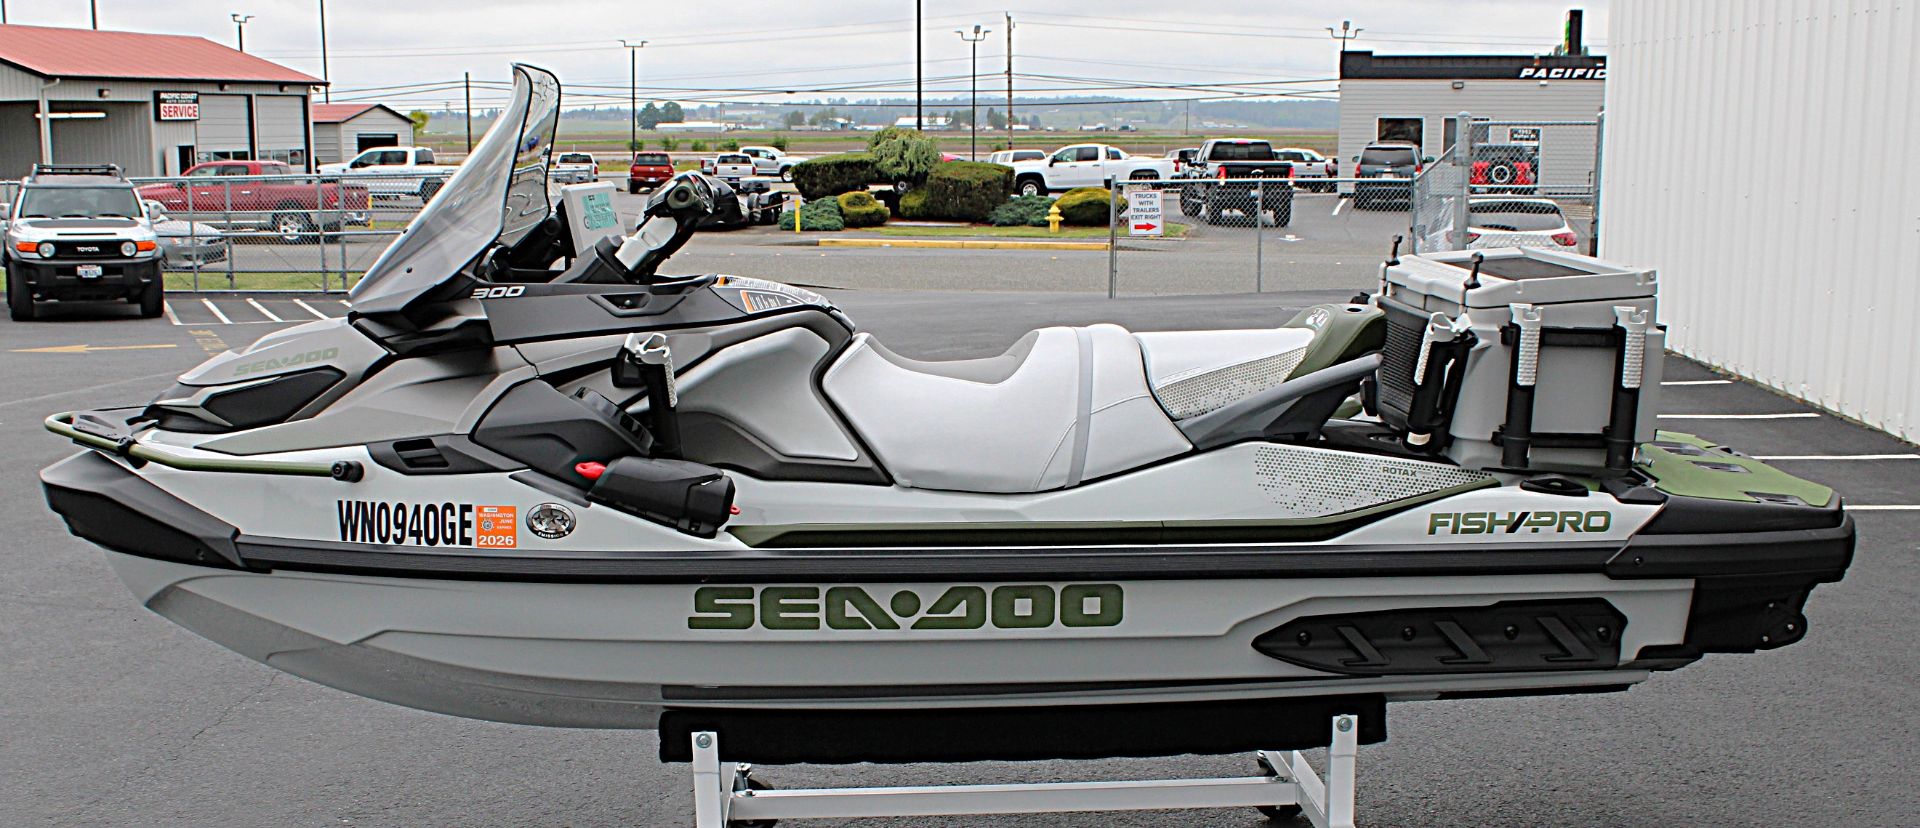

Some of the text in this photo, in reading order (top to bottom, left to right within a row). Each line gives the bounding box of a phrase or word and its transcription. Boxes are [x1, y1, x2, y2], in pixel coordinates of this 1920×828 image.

[162, 105, 198, 118] SERVICE
[470, 285, 526, 299] 300
[1382, 466, 1417, 477] ROTAX
[478, 535, 514, 546] 2026
